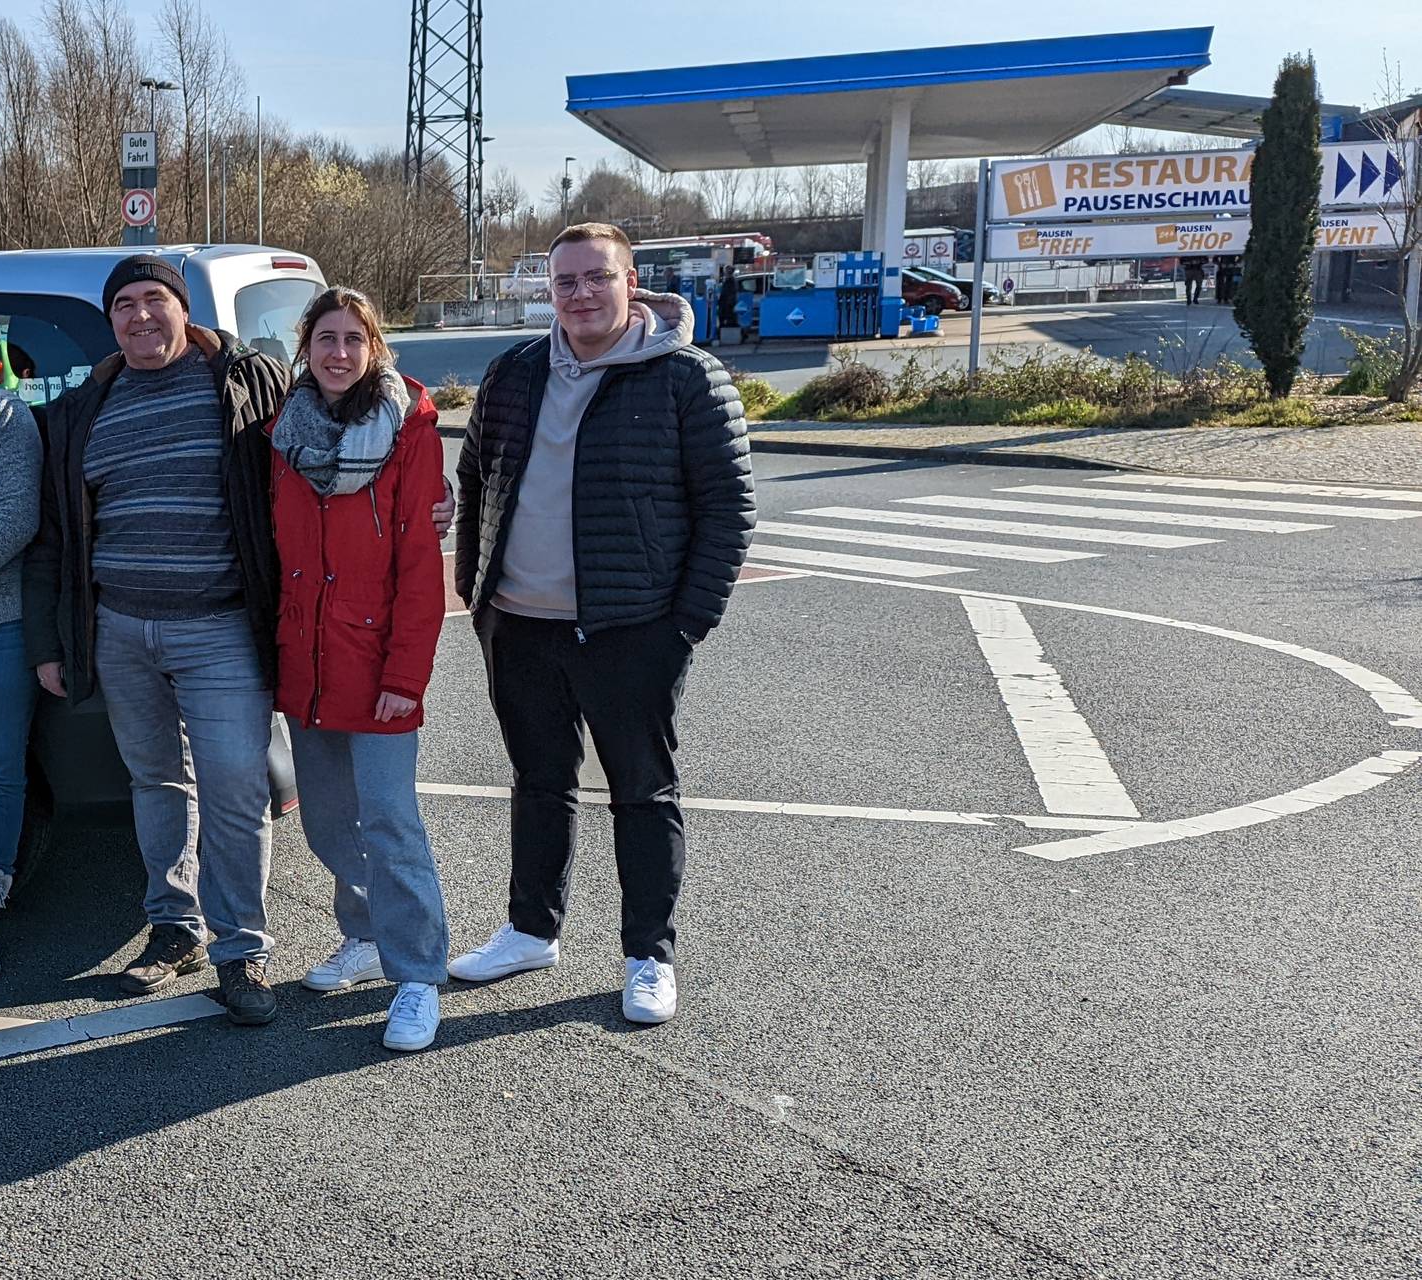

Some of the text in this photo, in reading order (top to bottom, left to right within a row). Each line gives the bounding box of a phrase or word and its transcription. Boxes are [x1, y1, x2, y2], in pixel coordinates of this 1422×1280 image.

[129, 137, 147, 148] Gute
[127, 151, 149, 163] Fahrt
[1318, 219, 1349, 228] USEN
[1037, 230, 1073, 238] PAUSEN
[1314, 226, 1378, 246] EVENT
[1040, 237, 1093, 255] TREFF
[1178, 231, 1233, 250] SHOP
